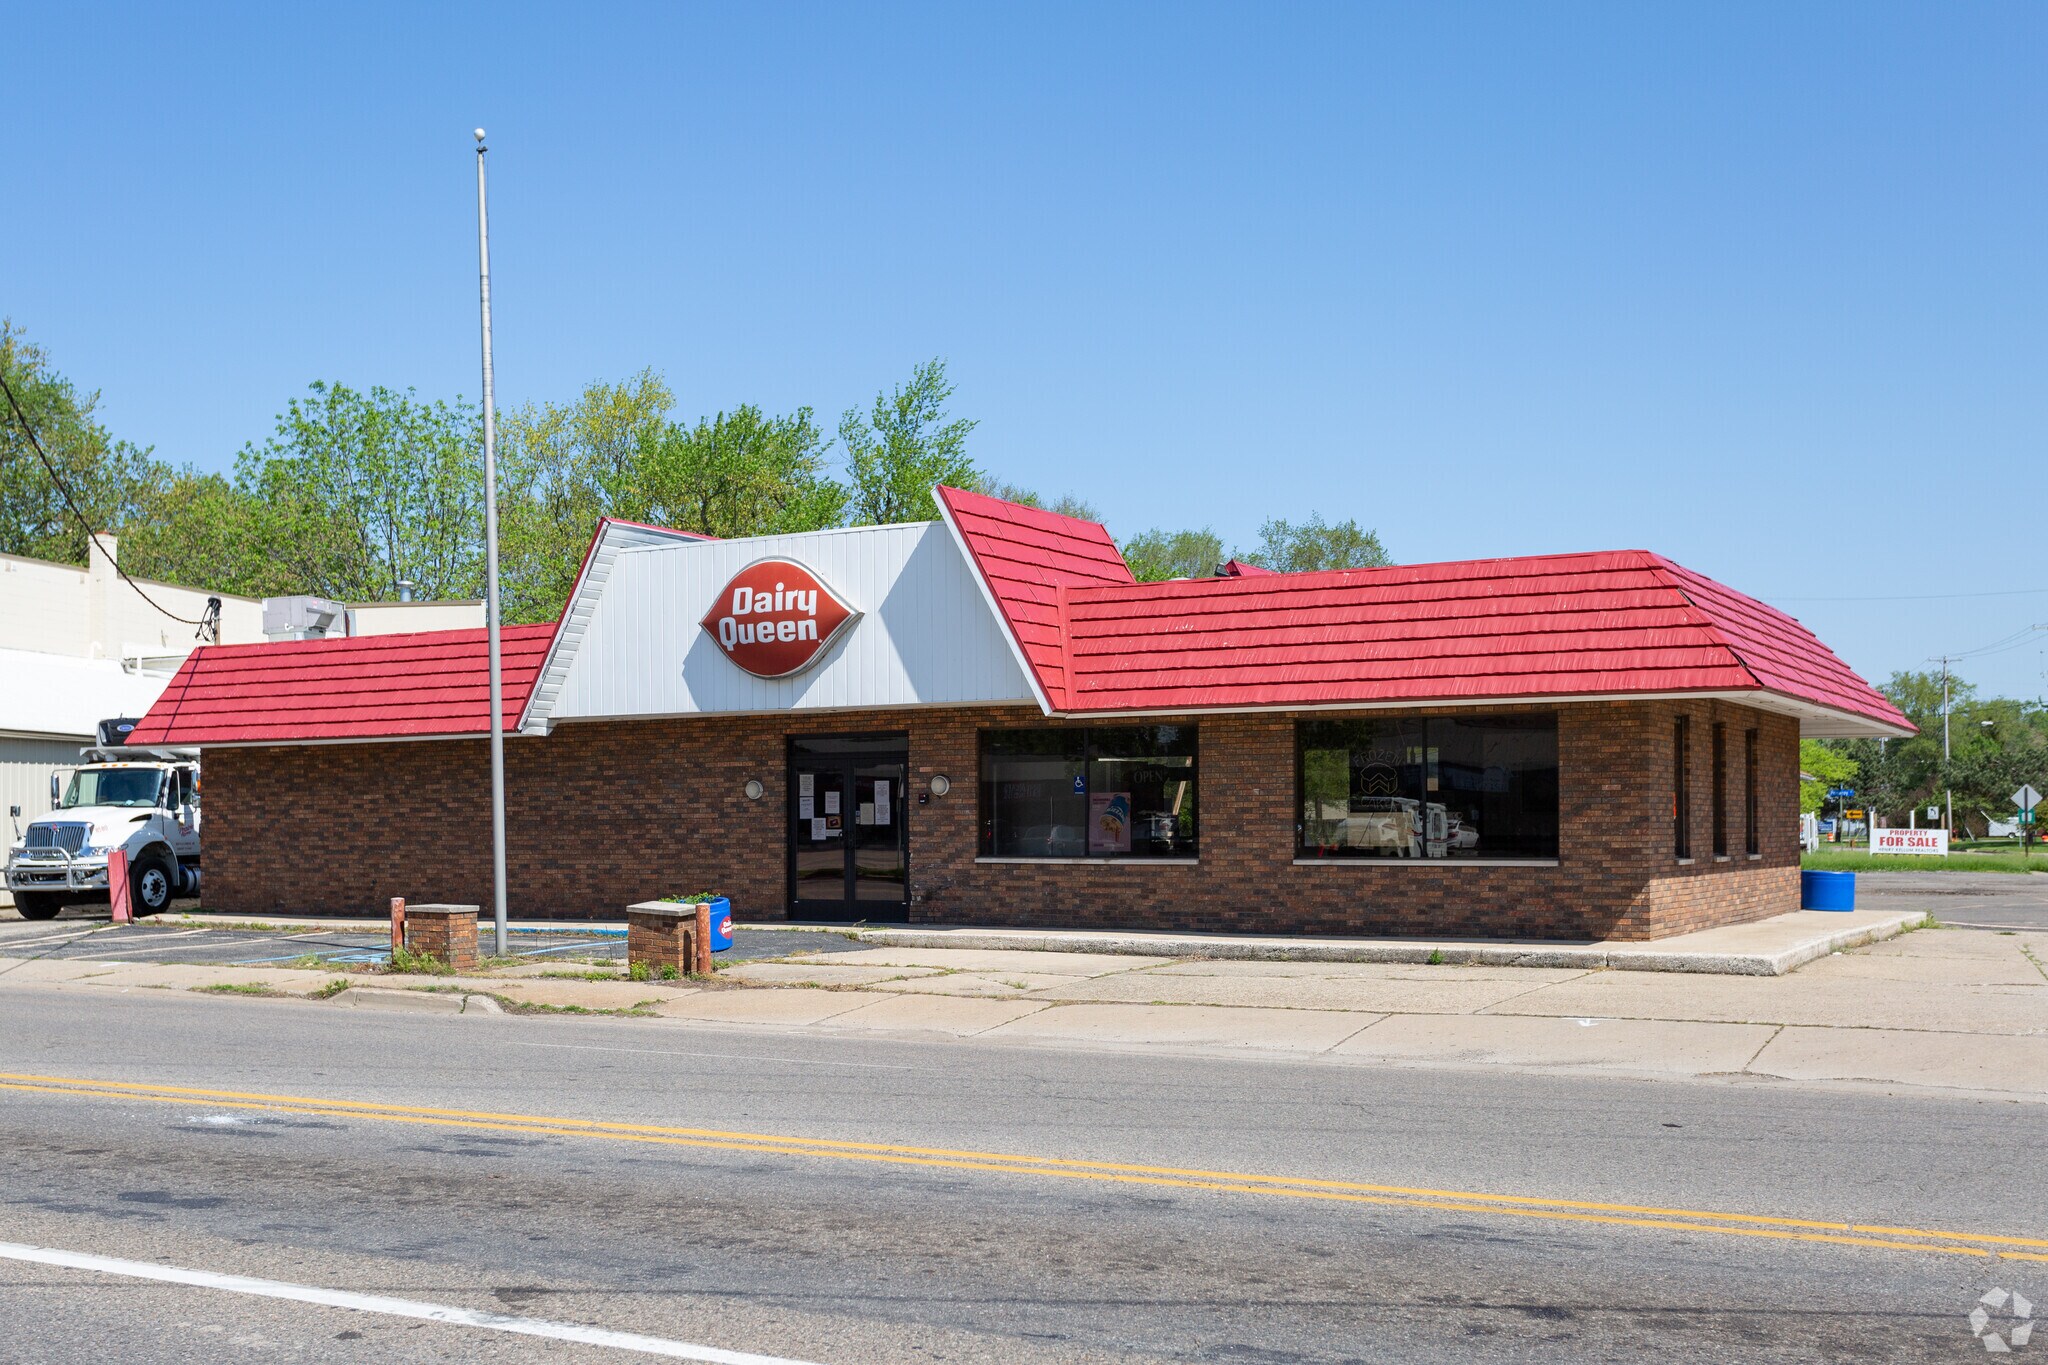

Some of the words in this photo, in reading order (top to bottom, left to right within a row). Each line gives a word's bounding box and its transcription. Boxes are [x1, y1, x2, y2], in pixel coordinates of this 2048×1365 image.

[732, 582, 818, 616] Dairy
[718, 616, 818, 651] Queen
[1352, 749, 1402, 768] FROZEN
[1134, 769, 1164, 784] OPEN
[1879, 836, 1904, 847] FOR
[1907, 837, 1938, 848] SALE
